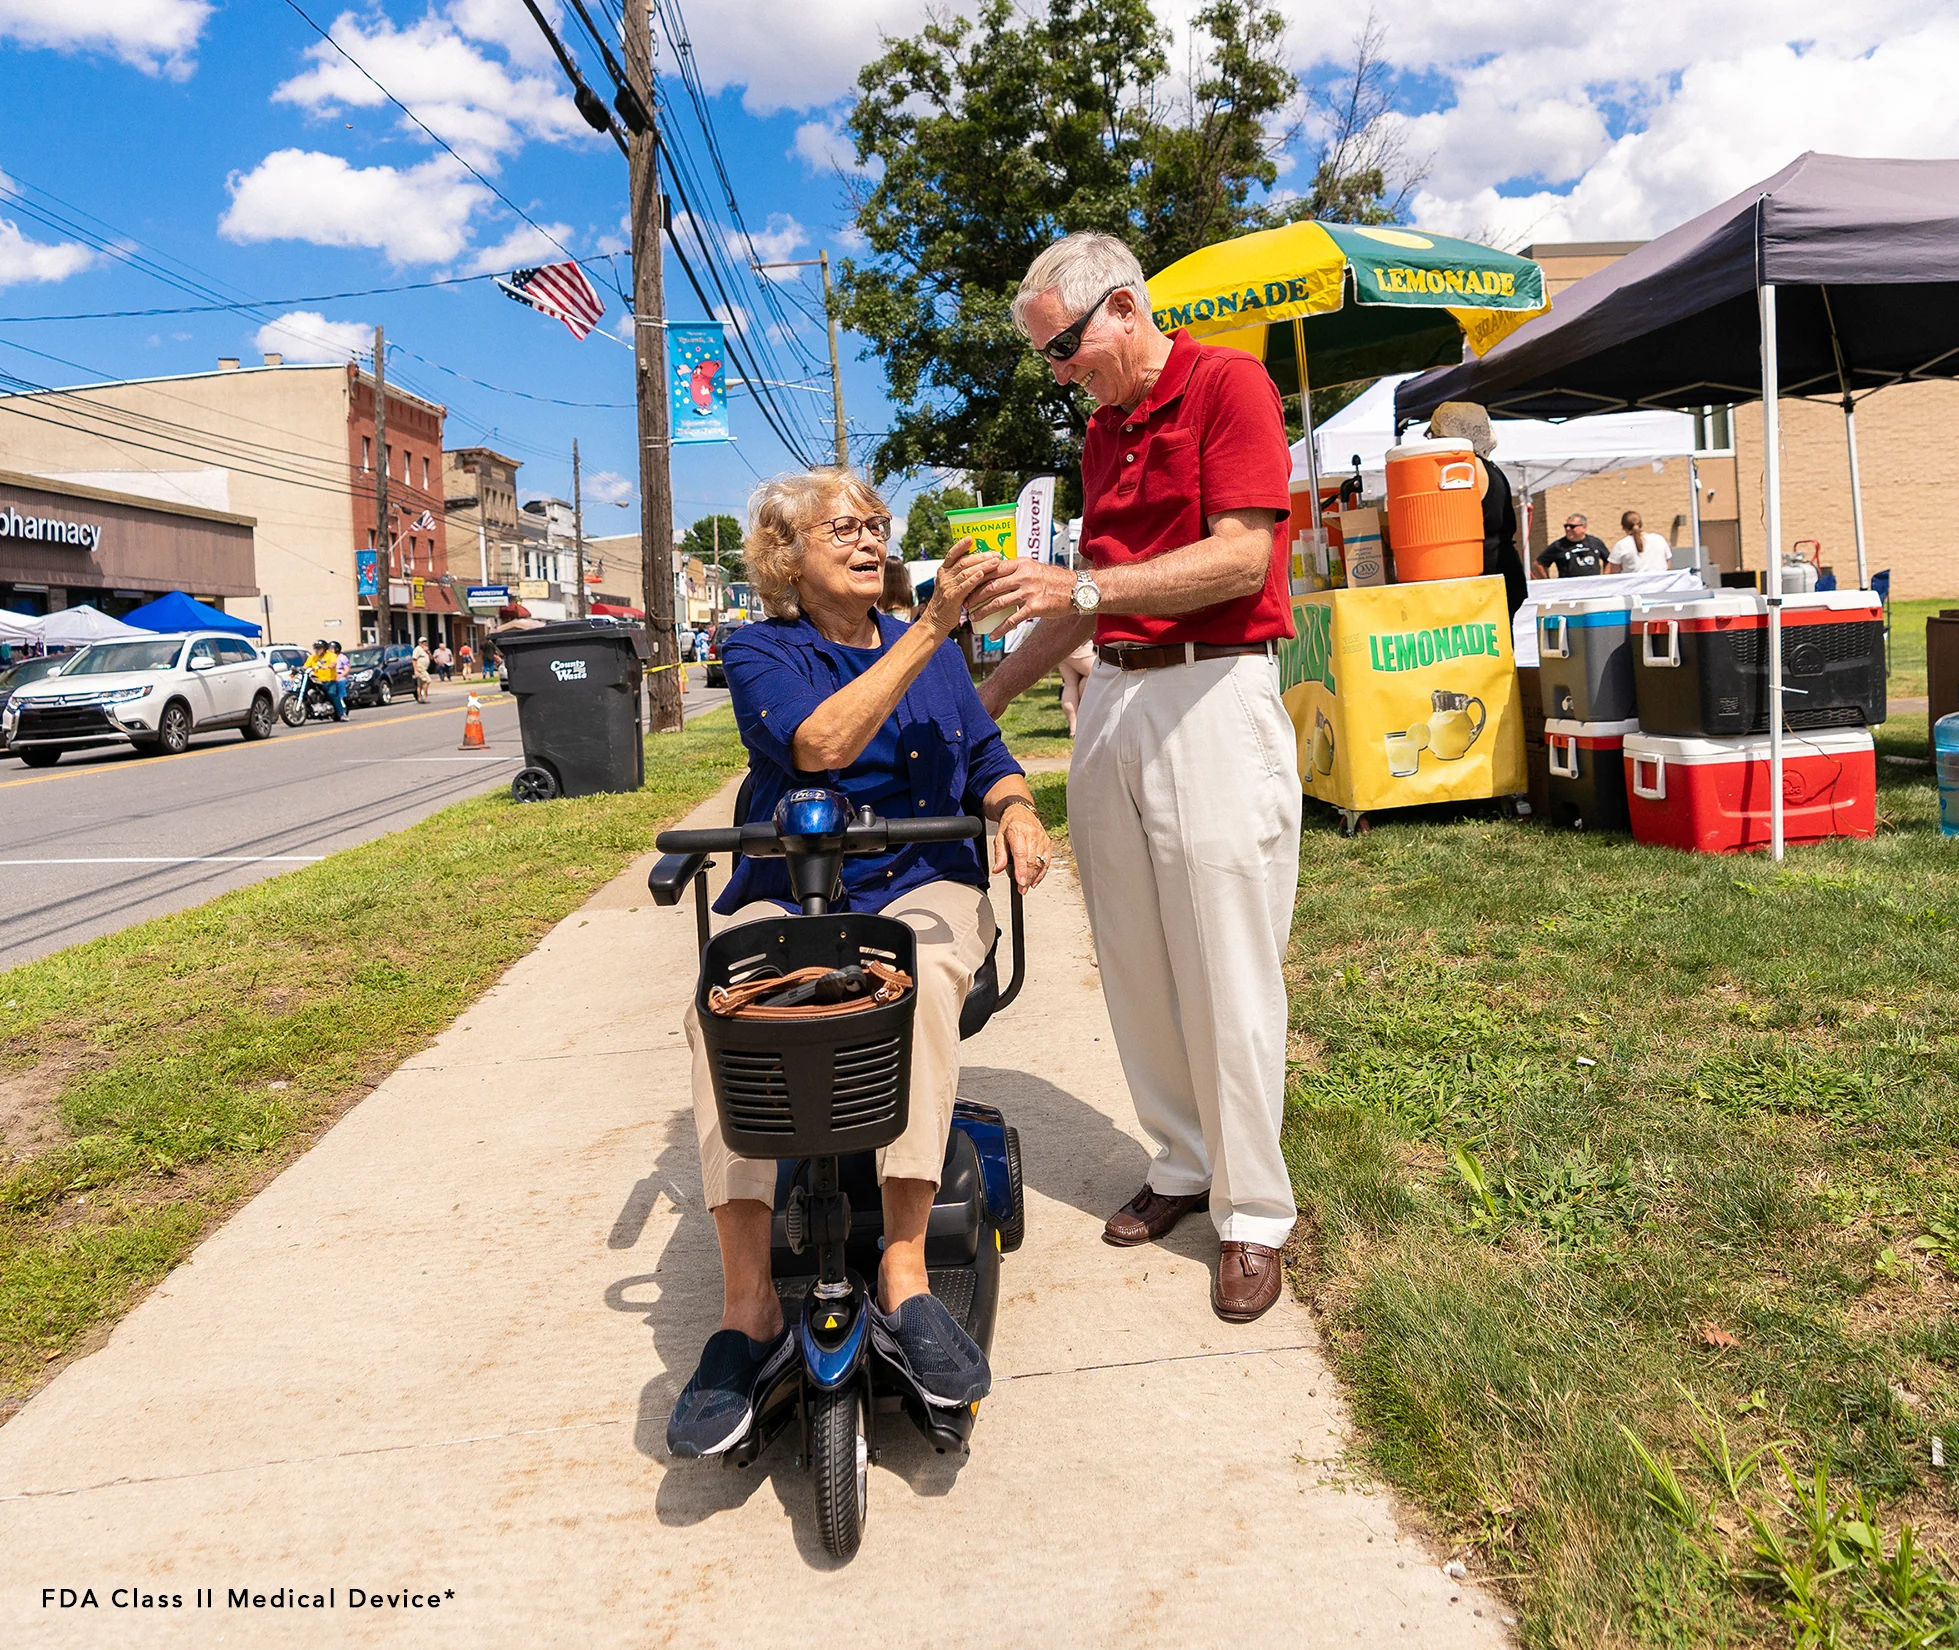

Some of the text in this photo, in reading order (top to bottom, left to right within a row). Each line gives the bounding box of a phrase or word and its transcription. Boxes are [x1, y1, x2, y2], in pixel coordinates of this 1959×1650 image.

[1373, 268, 1515, 297] LEMONADE
[1152, 277, 1309, 332] EMONADE
[961, 521, 1011, 534] LEMONADE
[1027, 496, 1041, 561] nSaver
[1369, 623, 1500, 672] LEMONADE
[550, 660, 586, 672] County
[555, 669, 588, 681] Waste
